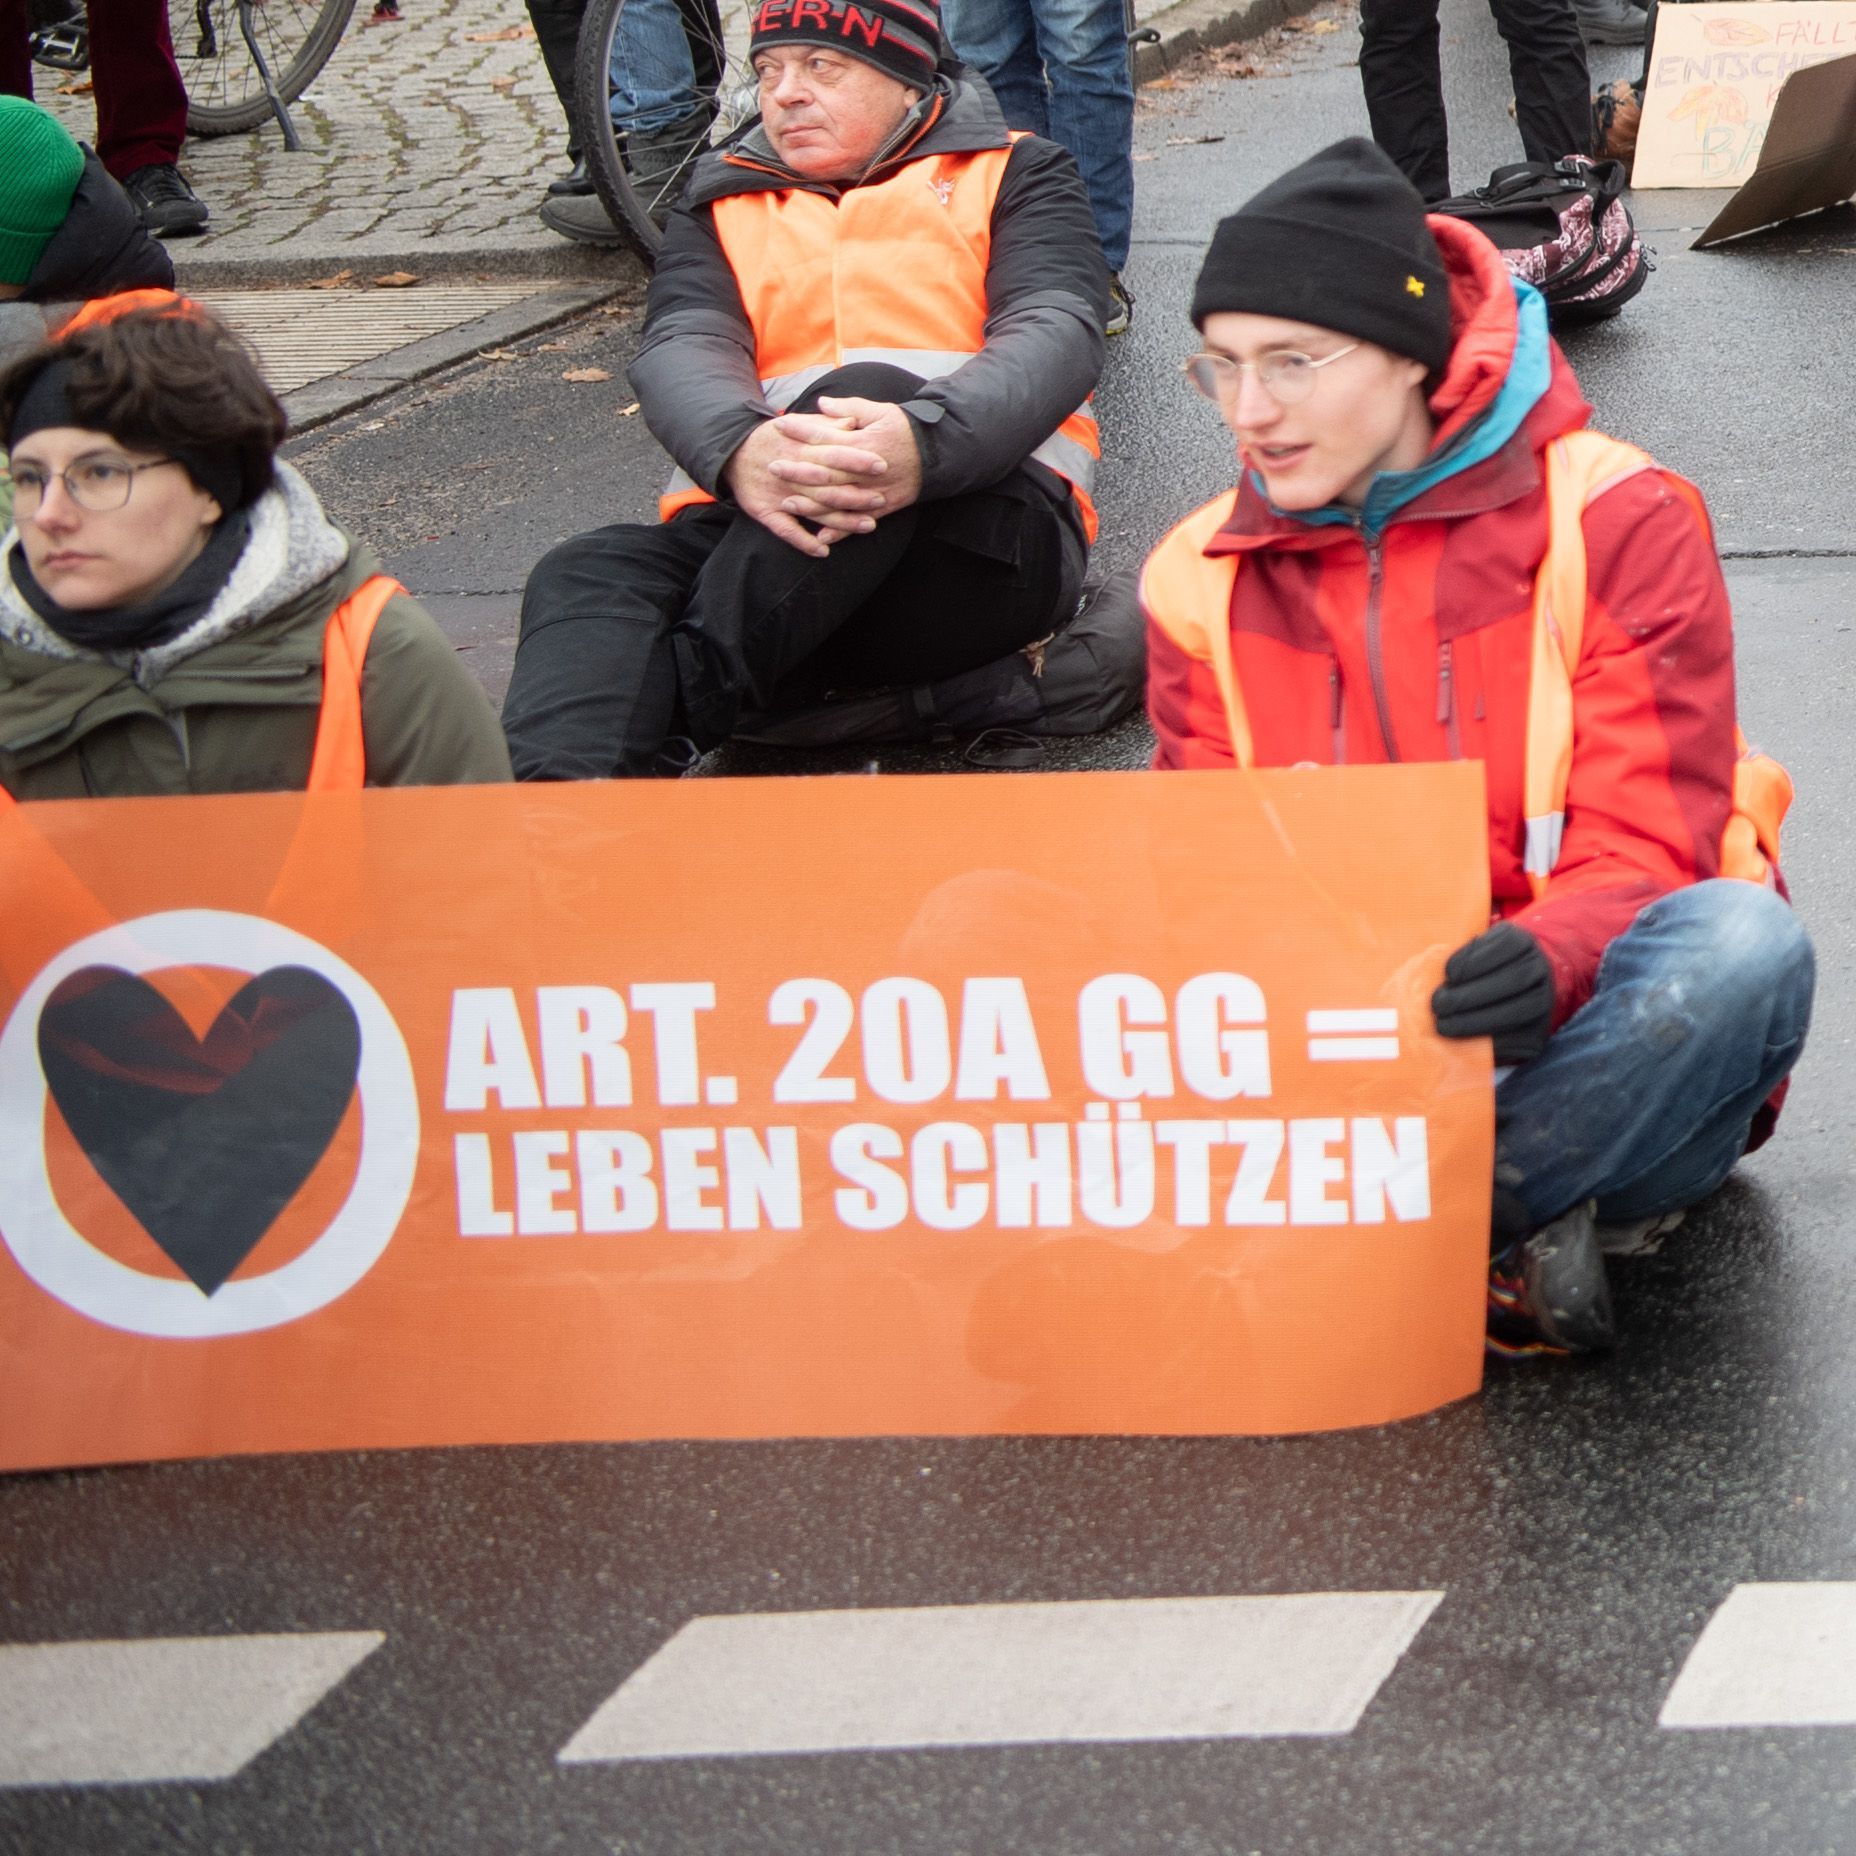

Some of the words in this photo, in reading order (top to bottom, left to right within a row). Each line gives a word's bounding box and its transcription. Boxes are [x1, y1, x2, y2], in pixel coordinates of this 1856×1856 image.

[444, 982, 740, 1113] ART.
[767, 976, 1050, 1105] 20A
[1078, 972, 1271, 1101] GG
[455, 1127, 803, 1238] LEBEN
[829, 1101, 1431, 1232] SCHÜTZEN
